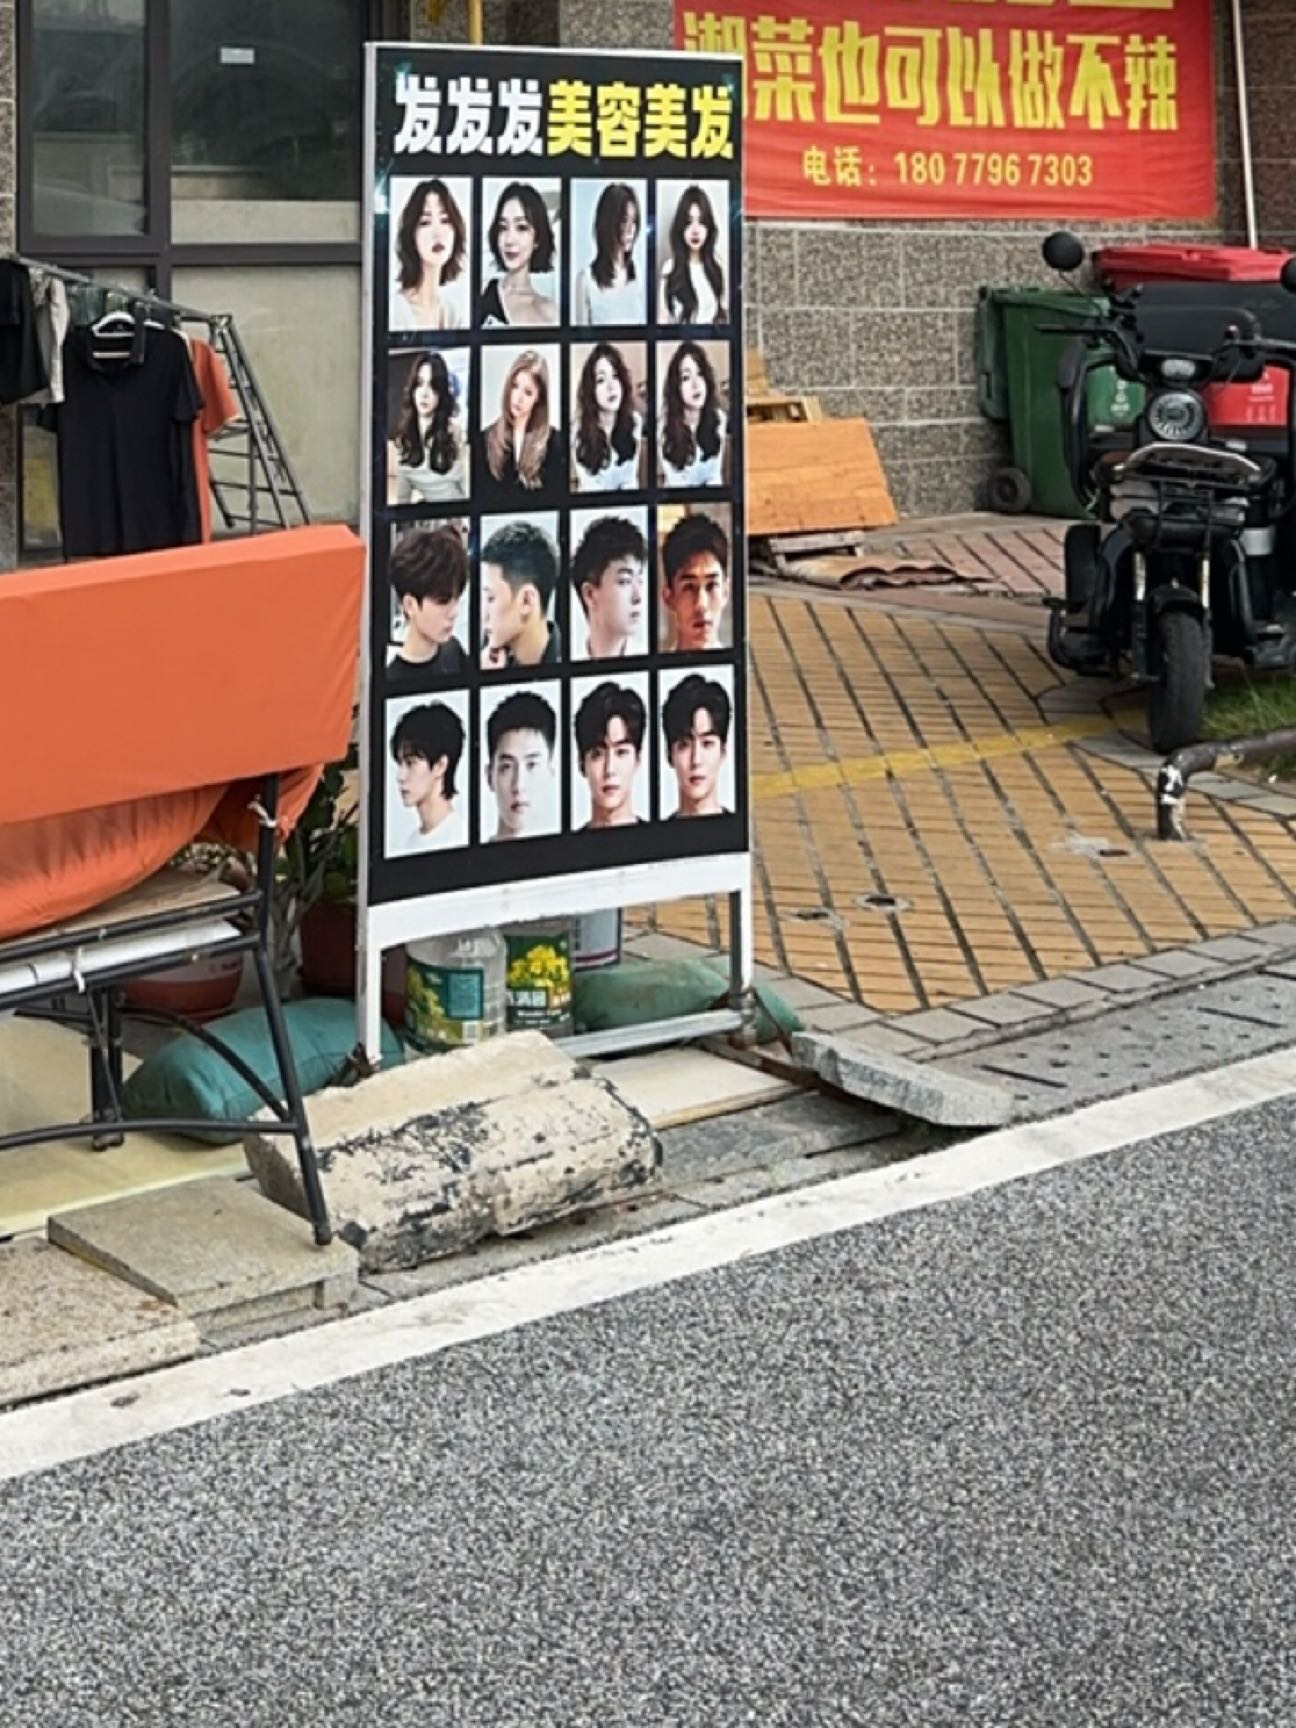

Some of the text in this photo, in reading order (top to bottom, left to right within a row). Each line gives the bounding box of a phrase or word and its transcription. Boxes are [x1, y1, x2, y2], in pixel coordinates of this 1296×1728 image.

[394, 74, 733, 159] 发发发美容美发
[894, 151, 946, 186] 180
[954, 153, 1021, 187] 7796
[1028, 153, 1094, 188] 7303
